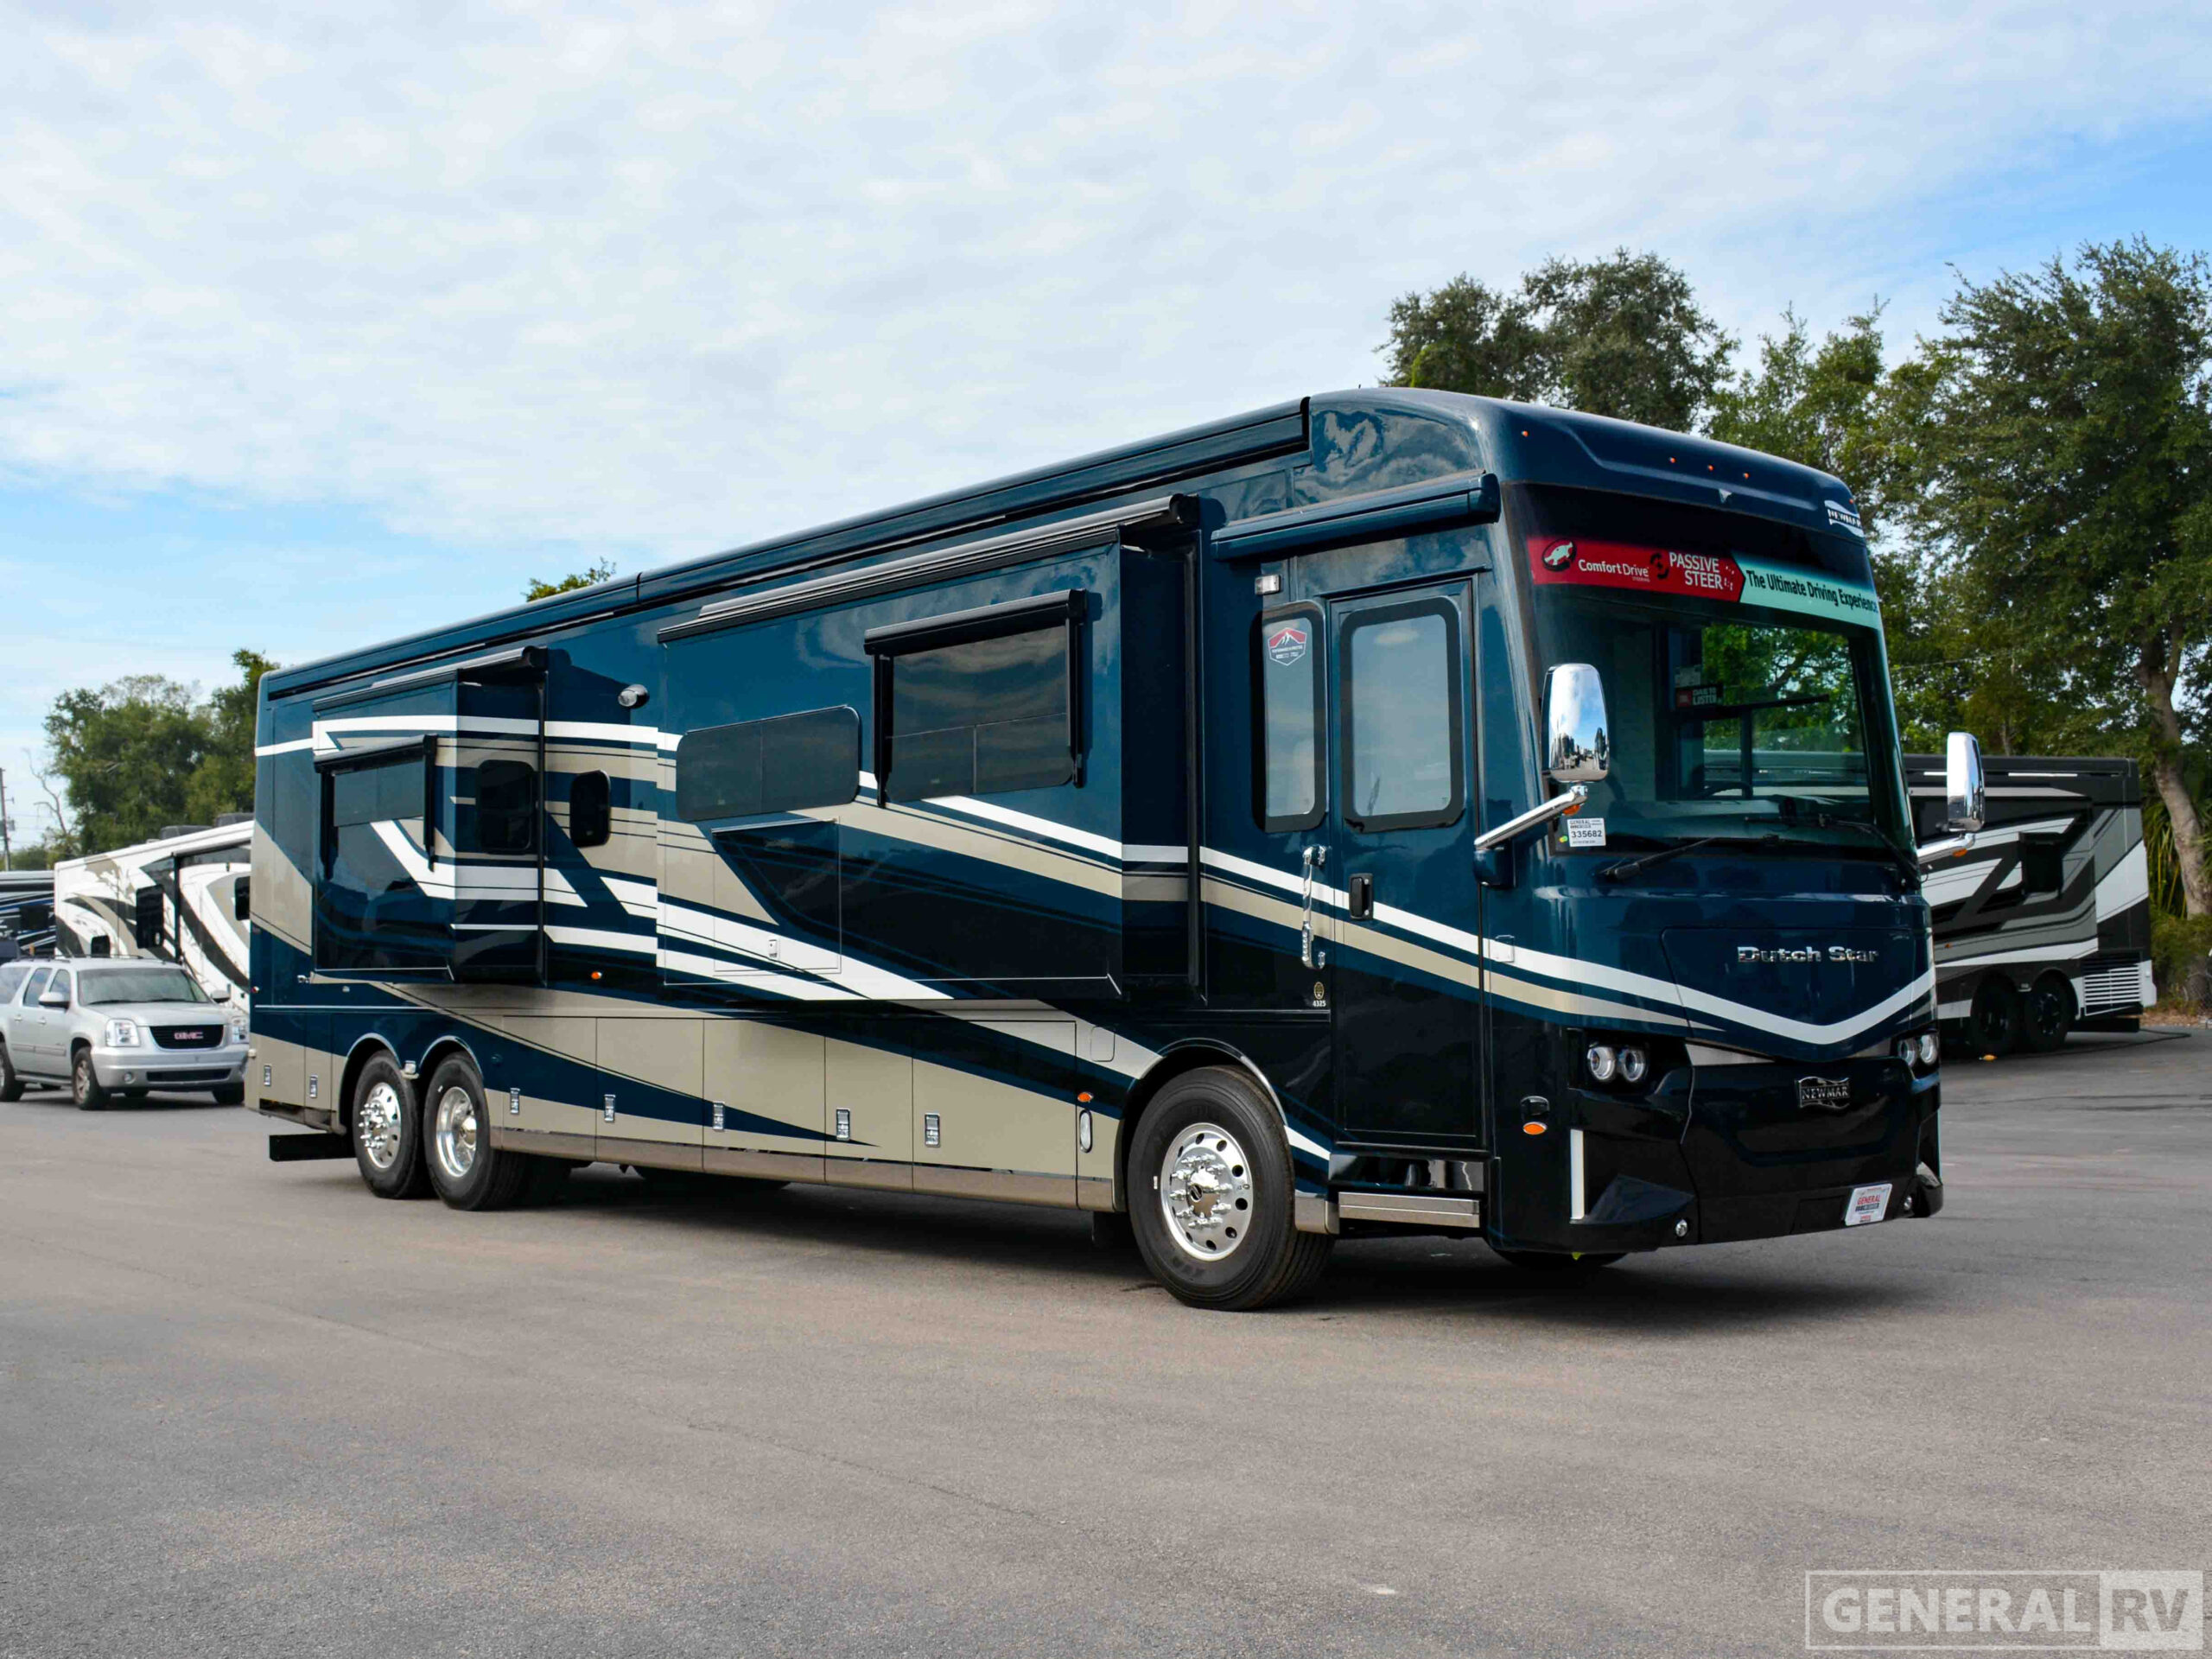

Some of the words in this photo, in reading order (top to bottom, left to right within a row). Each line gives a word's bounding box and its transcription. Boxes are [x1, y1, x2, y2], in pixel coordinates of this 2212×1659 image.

[1578, 559, 1622, 575] Comfort
[1623, 563, 1649, 577] Drive
[1669, 550, 1719, 574] PASSIVE
[1685, 569, 1724, 590] STEER
[1746, 569, 1766, 588] The
[1766, 573, 1807, 596] Ultimate
[1807, 582, 1839, 607] Driving
[1737, 946, 1821, 963] Dutch
[1827, 945, 1878, 962] Star
[174, 1032, 204, 1040] GMC
[1802, 1086, 1848, 1100] NEWMAR
